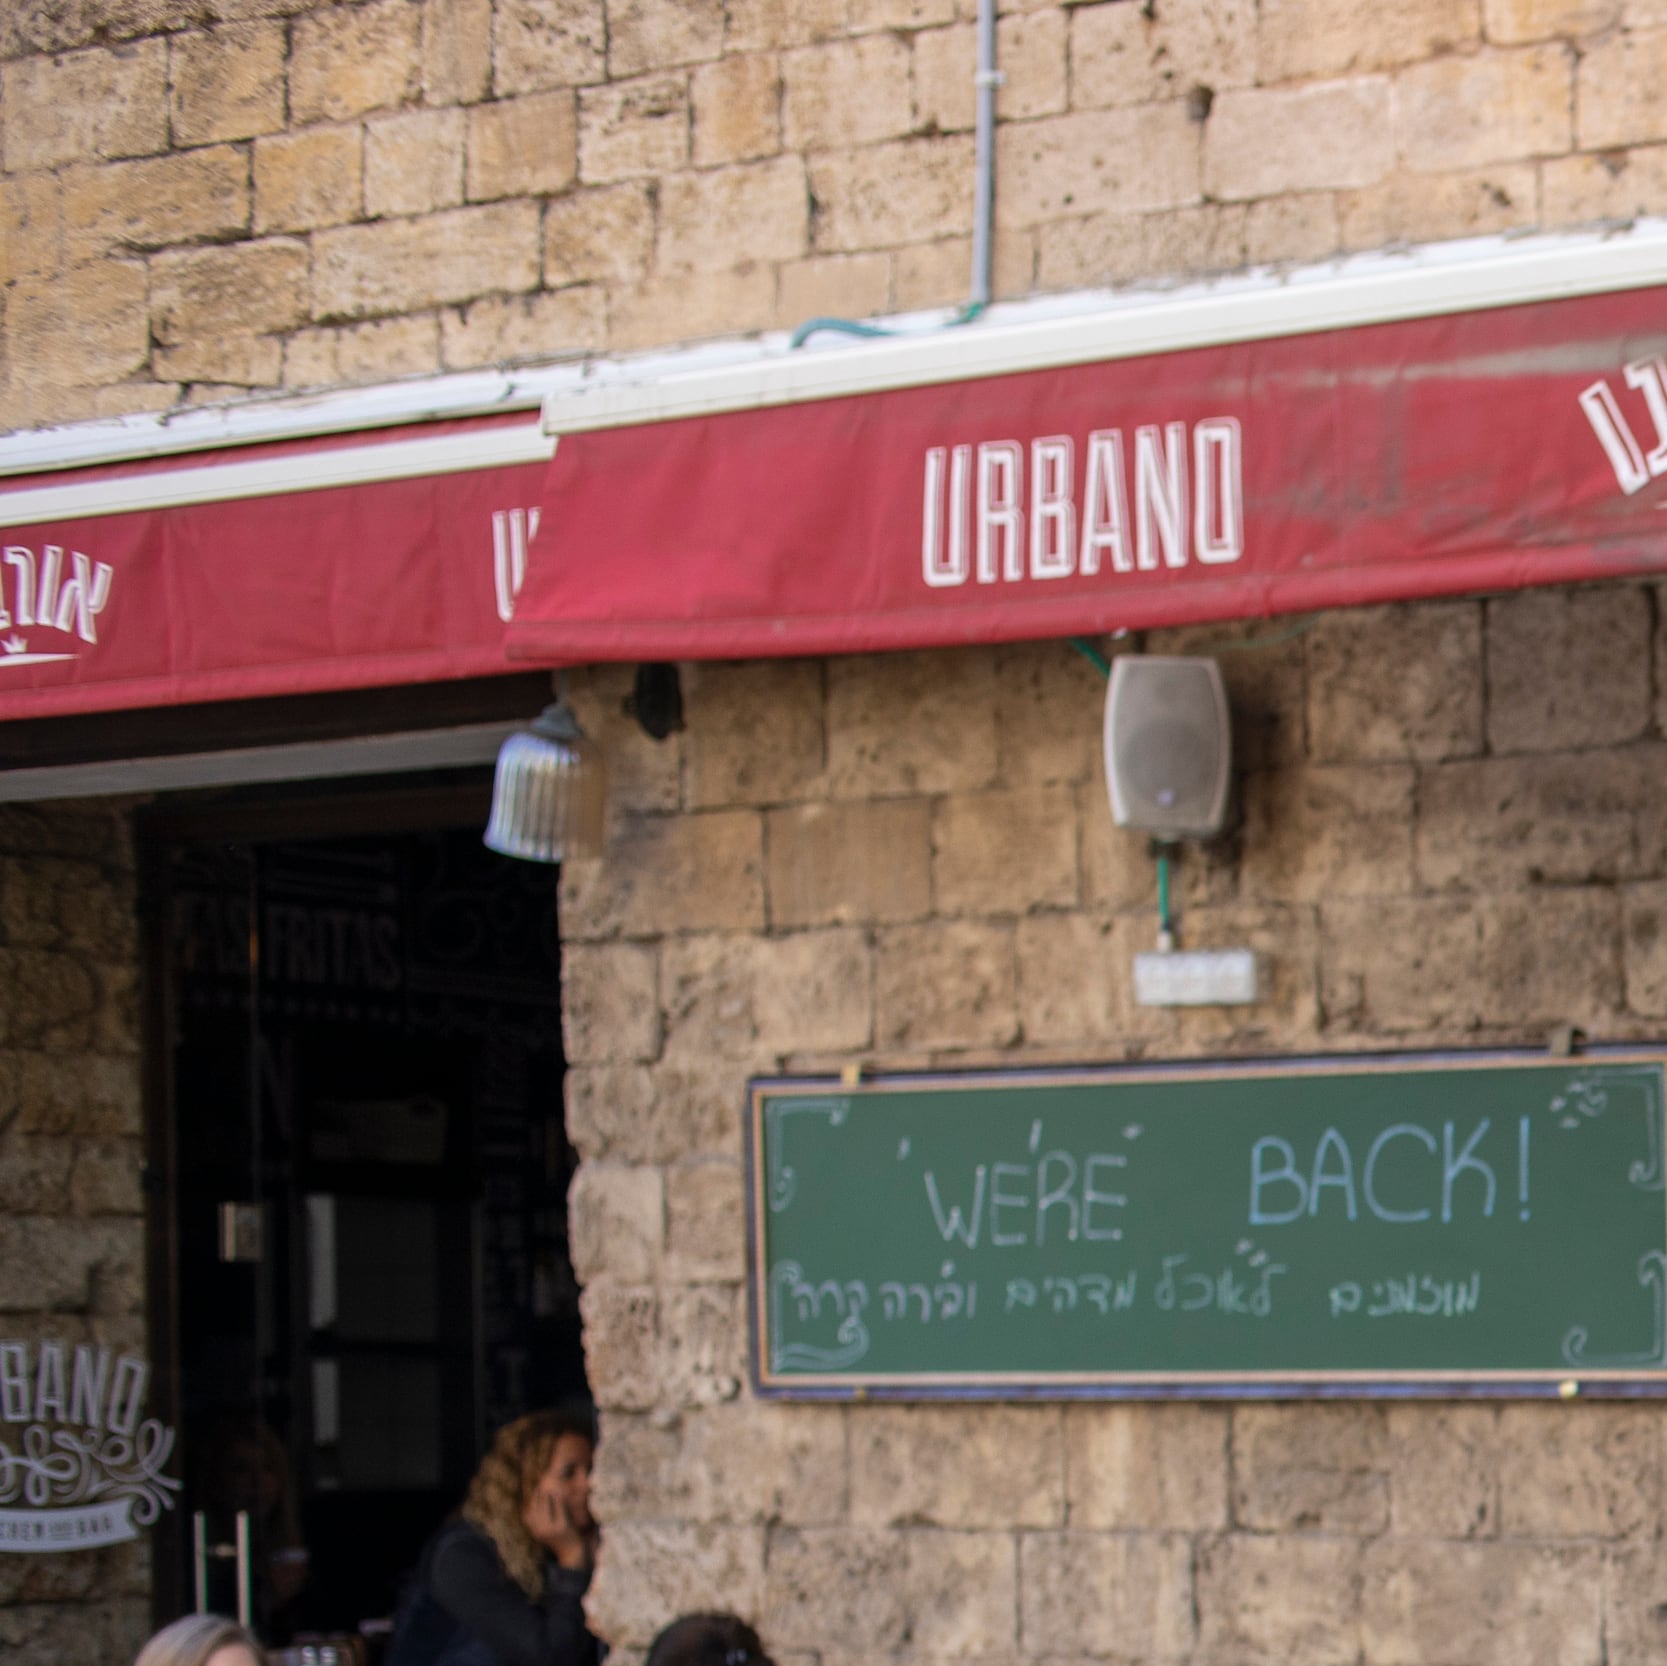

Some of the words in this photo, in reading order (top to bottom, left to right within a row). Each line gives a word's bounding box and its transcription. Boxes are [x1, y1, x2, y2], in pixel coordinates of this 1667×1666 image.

[922, 416, 1244, 588] URBANO
[0, 544, 113, 645] אור
[492, 506, 542, 623] U
[923, 1117, 1128, 1250] WE'RE
[1249, 1114, 1531, 1225] BACK!
[1004, 1270, 1137, 1314] מדהים
[1154, 1254, 1289, 1317] לאוכל
[1328, 1272, 1481, 1318] מוזמנים
